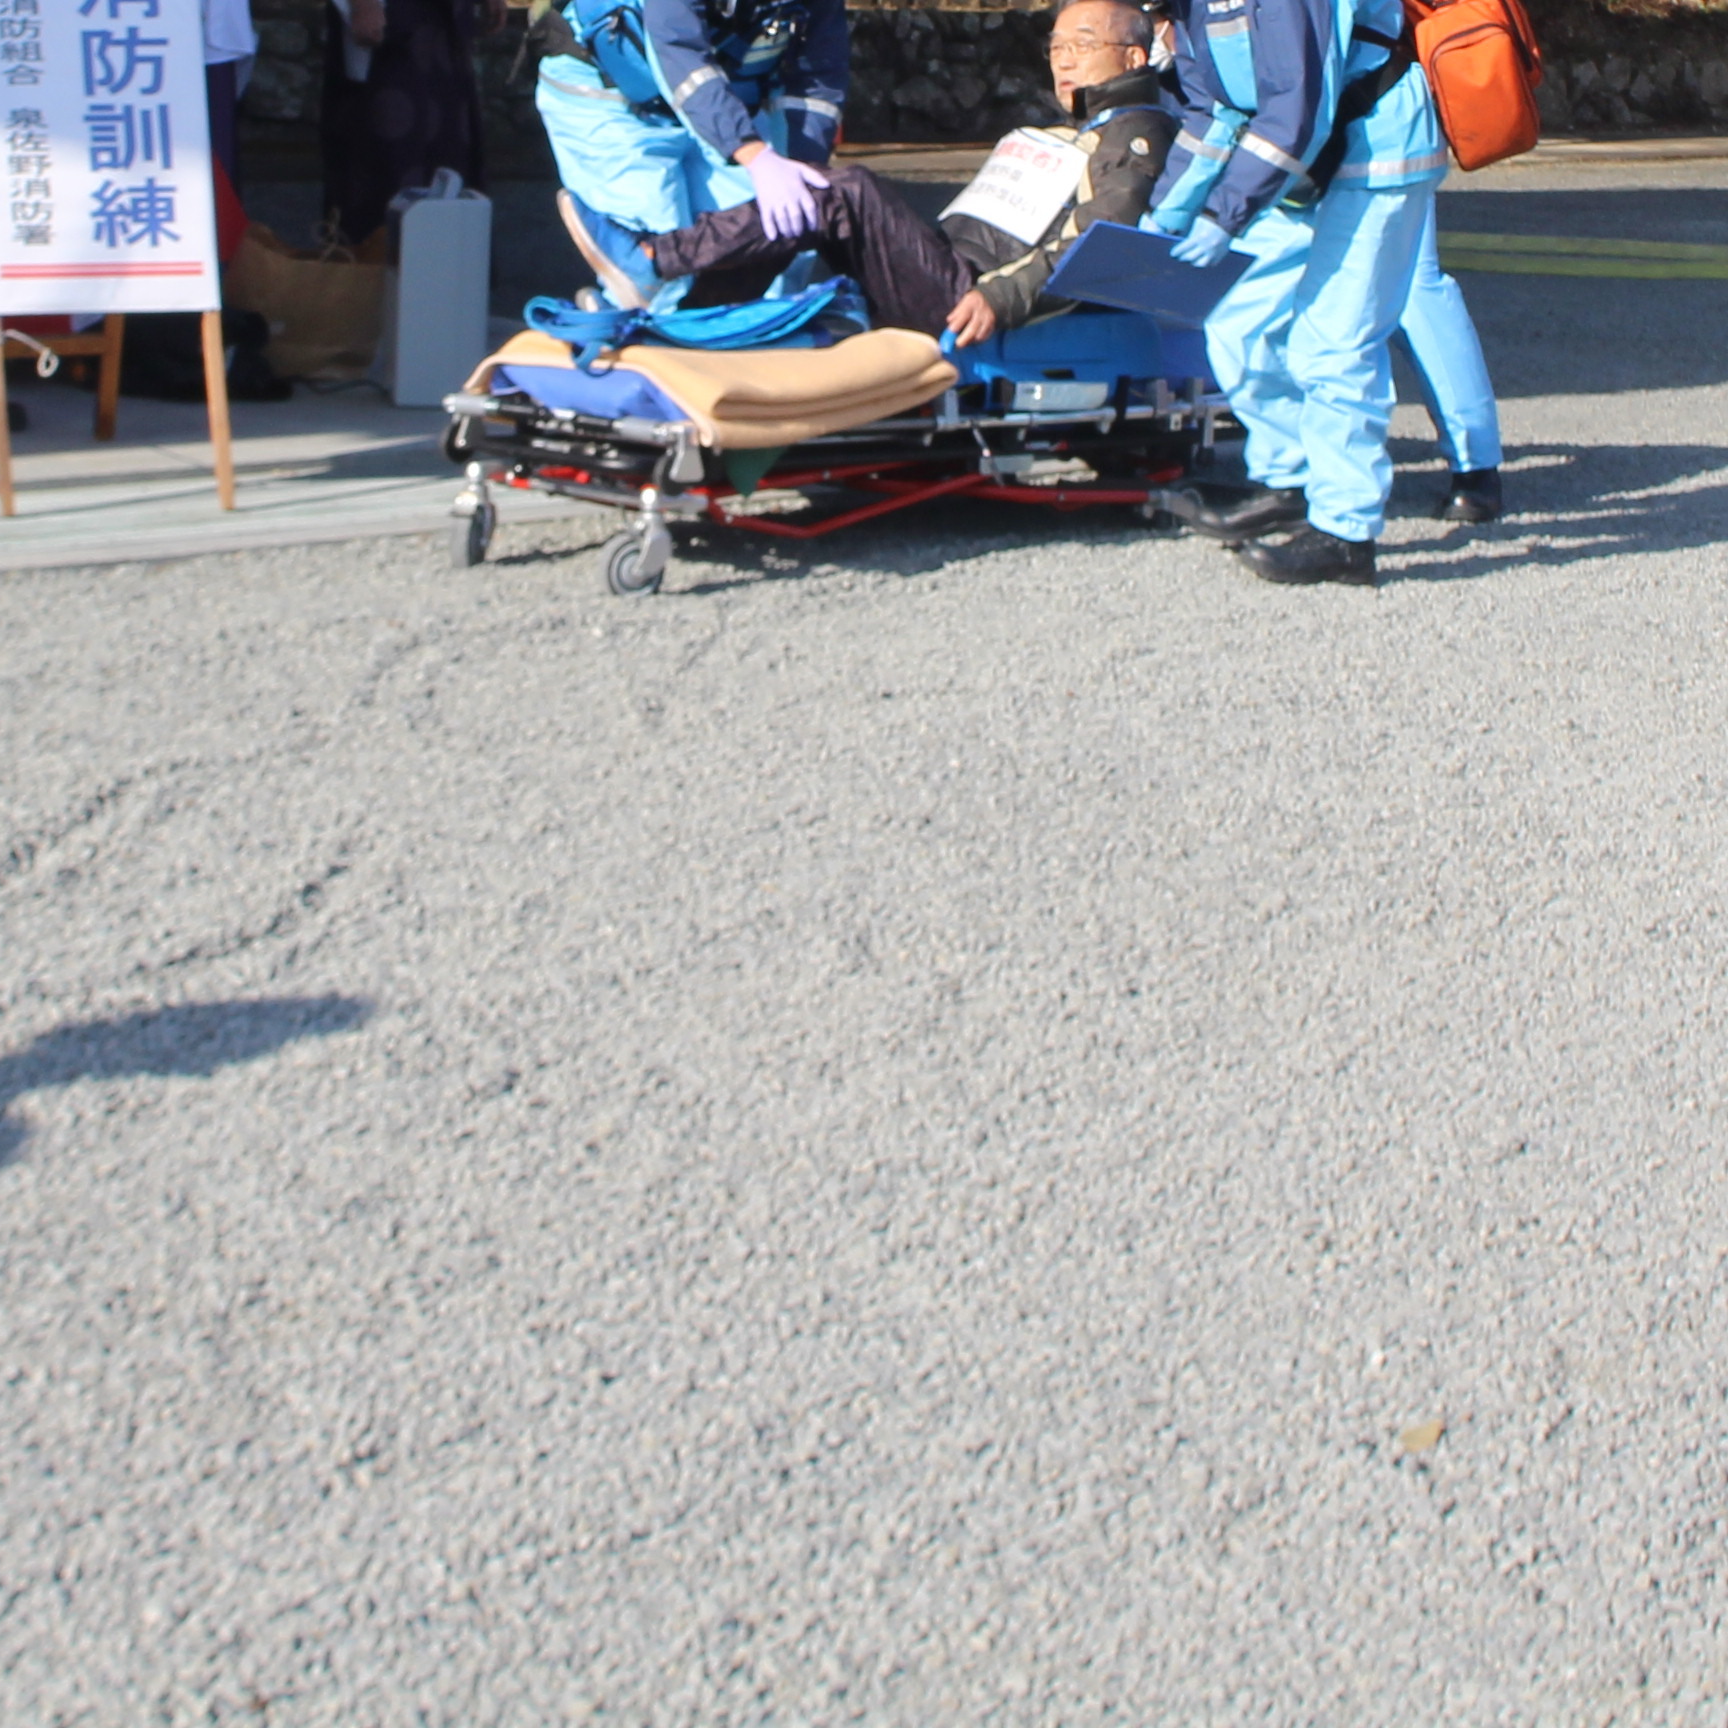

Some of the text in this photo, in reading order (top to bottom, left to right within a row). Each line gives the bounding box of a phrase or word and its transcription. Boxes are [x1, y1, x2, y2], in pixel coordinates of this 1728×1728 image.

[4, 107, 55, 247] 泉佐野消防署
